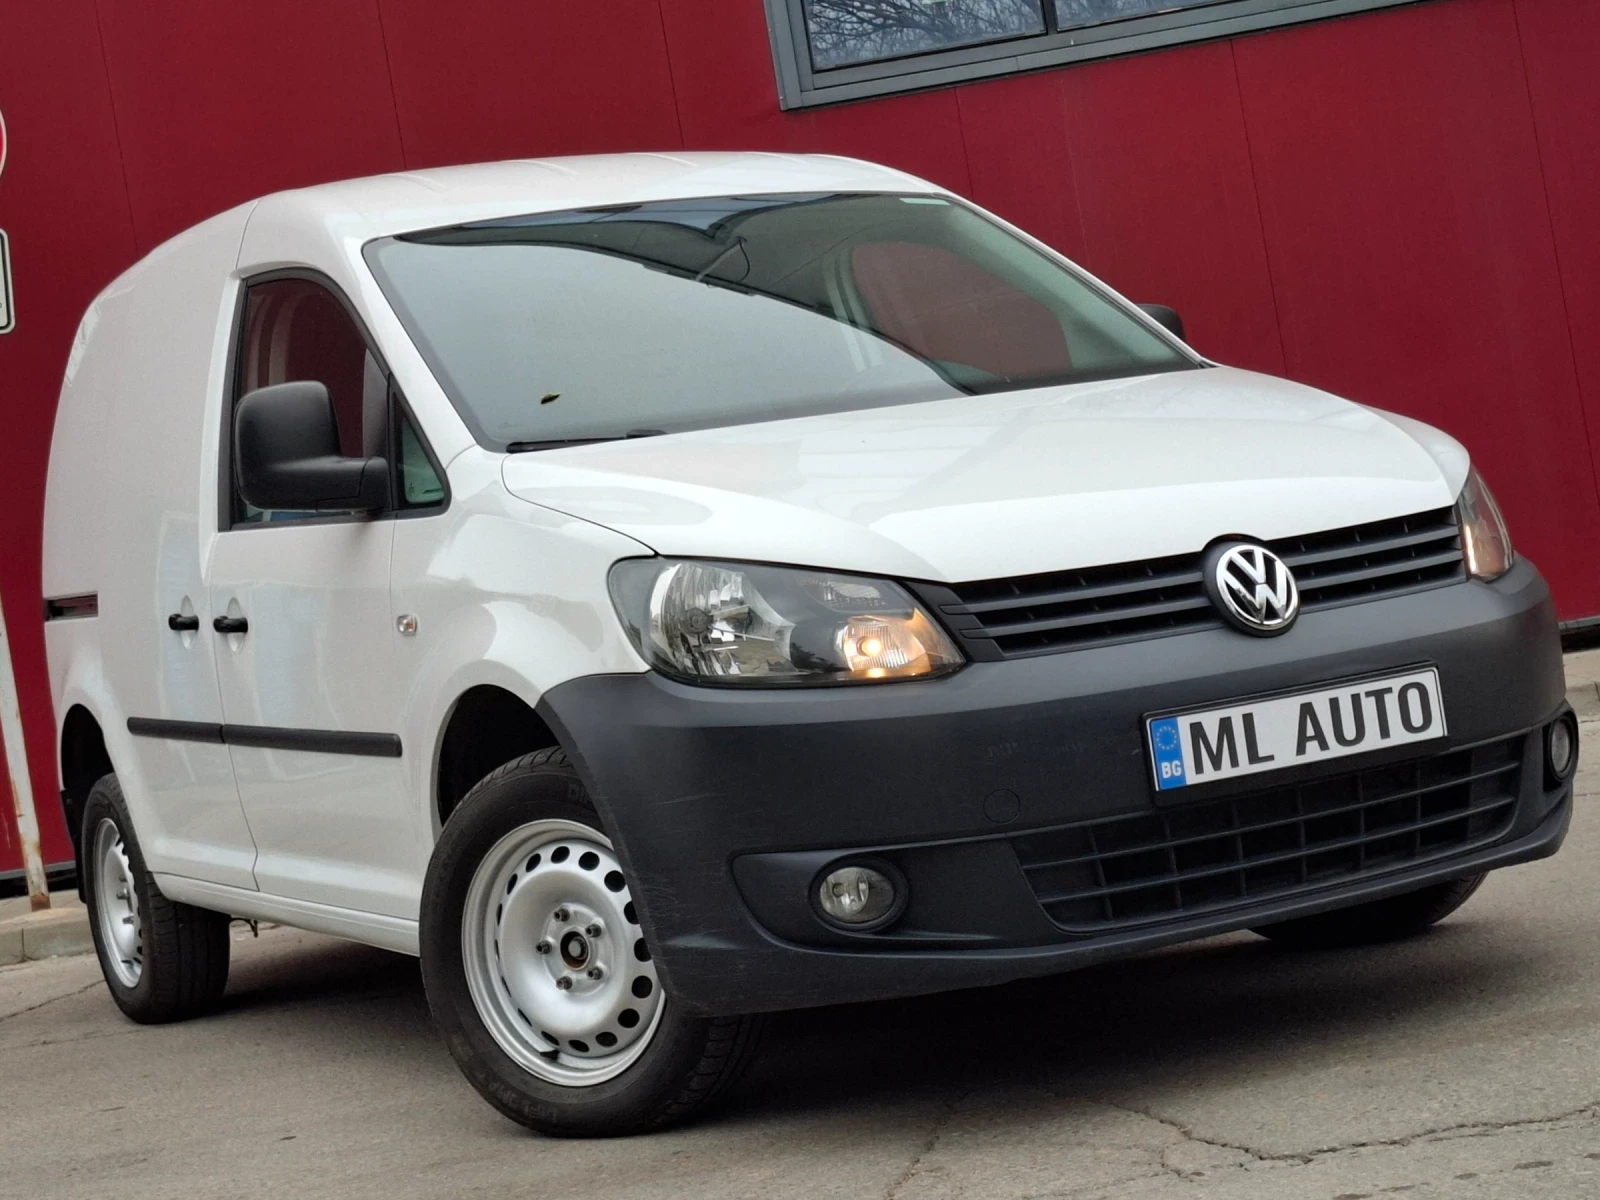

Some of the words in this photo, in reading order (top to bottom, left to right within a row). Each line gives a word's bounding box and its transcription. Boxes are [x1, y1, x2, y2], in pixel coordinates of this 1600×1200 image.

[1216, 545, 1298, 630] VW
[1161, 761, 1182, 778] BG
[1189, 712, 1275, 775] ML
[1296, 682, 1432, 756] AUTO
